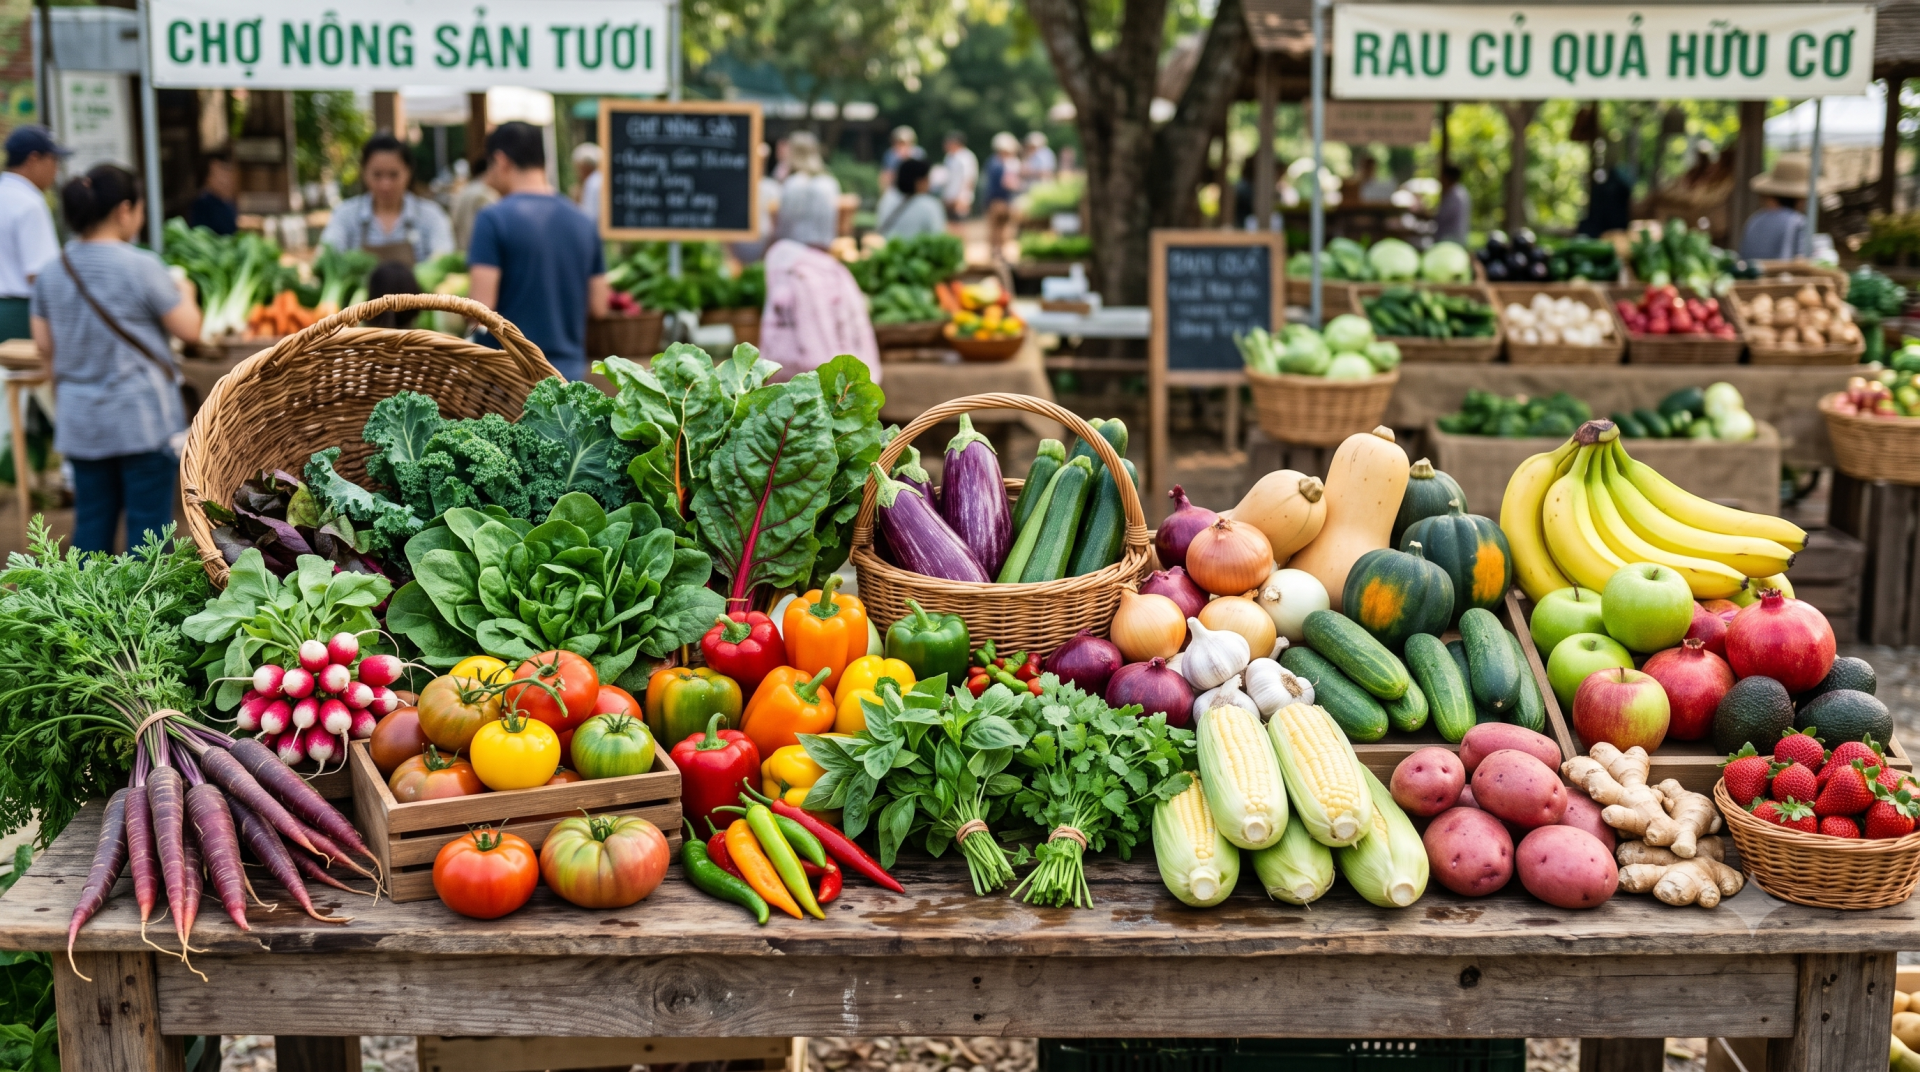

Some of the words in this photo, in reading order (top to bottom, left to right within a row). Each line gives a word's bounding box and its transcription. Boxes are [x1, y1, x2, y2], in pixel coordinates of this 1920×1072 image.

[167, 17, 263, 77] CHỢ
[281, 10, 414, 66] NÔNG
[434, 6, 530, 68] SẢN
[549, 20, 653, 70] TƯƠI
[1354, 32, 1448, 76] RAU
[1469, 12, 1531, 78] CỦ
[1552, 12, 1647, 83] QUẢ
[1668, 19, 1767, 78] HỮU
[1788, 28, 1855, 78] CƠ
